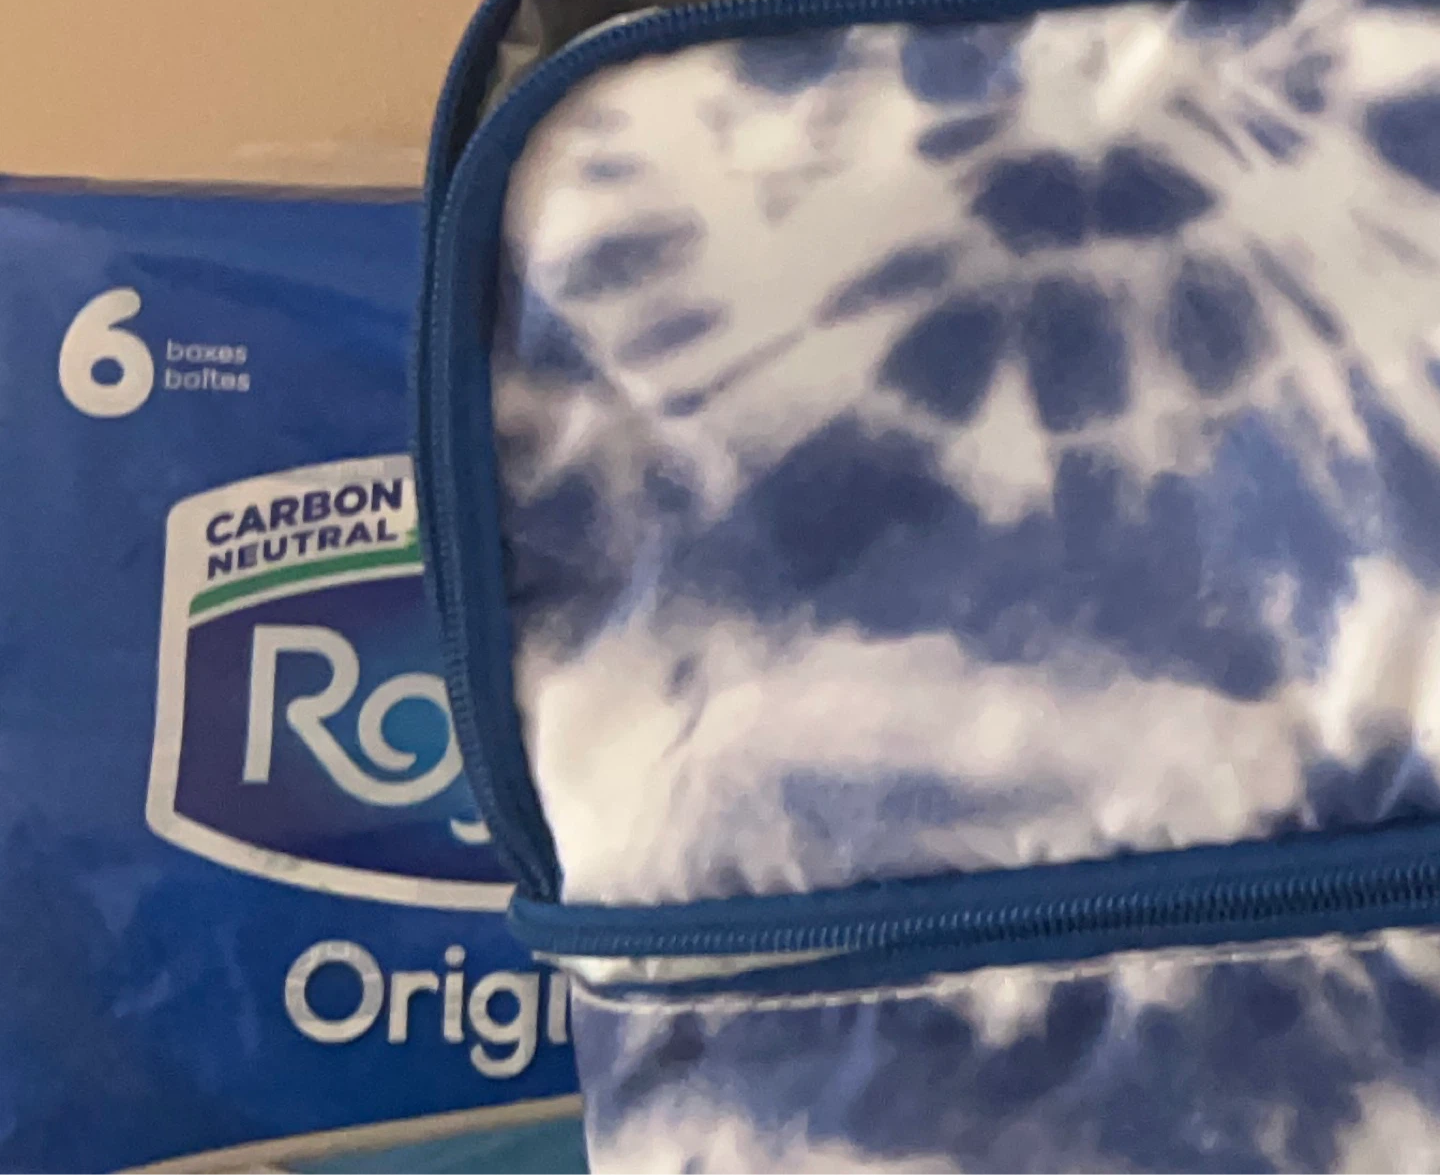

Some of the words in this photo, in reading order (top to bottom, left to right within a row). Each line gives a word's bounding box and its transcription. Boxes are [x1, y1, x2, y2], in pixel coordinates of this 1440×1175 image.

[59, 285, 154, 418] 6
[165, 338, 248, 364] boxes
[205, 477, 404, 547] CARBON
[206, 518, 398, 581] NEUTRAL
